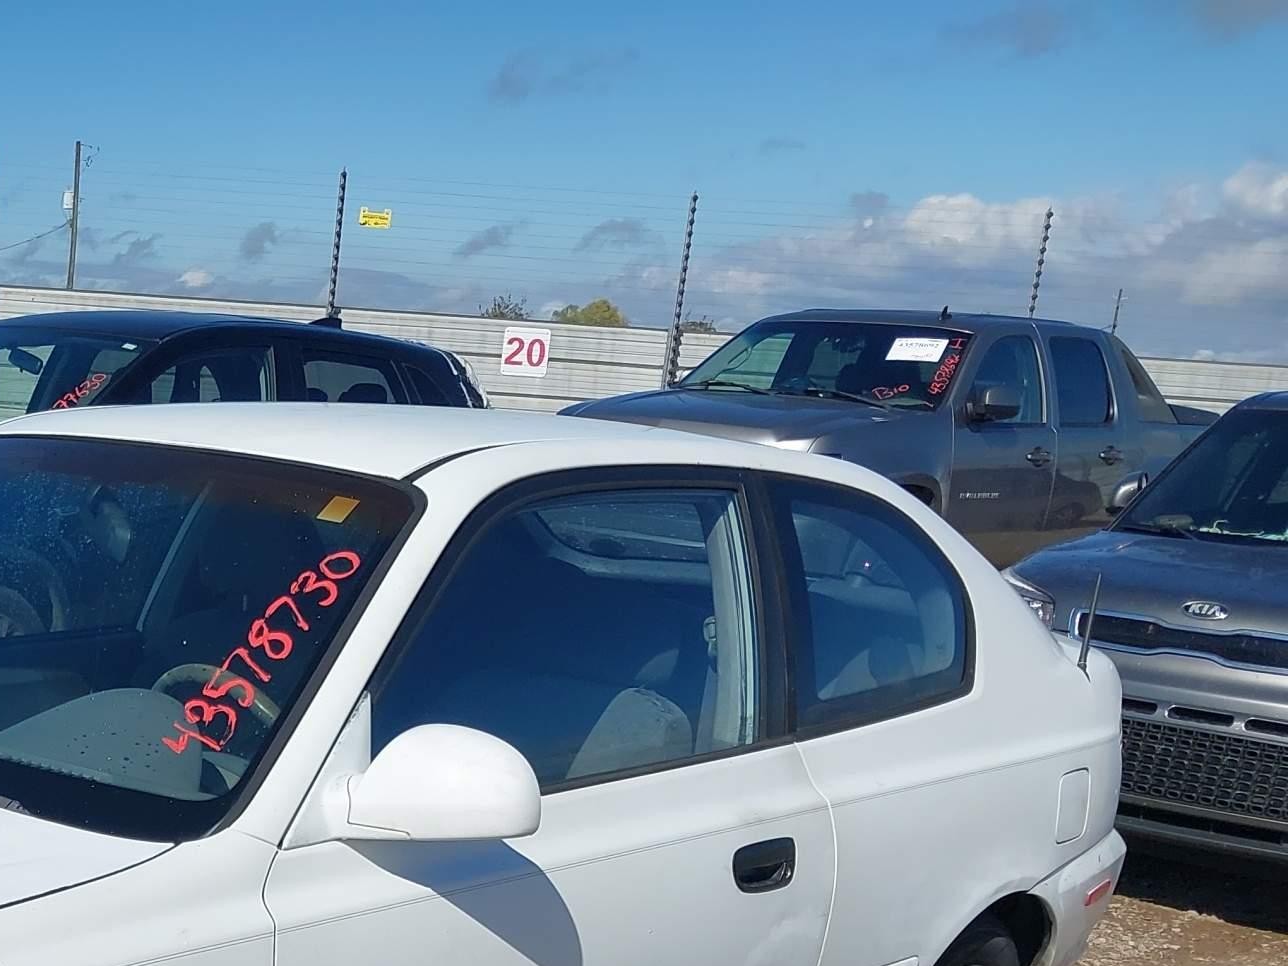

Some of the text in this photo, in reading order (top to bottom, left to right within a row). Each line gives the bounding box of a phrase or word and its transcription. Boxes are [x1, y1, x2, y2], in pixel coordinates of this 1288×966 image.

[504, 337, 546, 367] 20
[1188, 603, 1221, 617] KIA
[161, 551, 361, 754] 43578730
